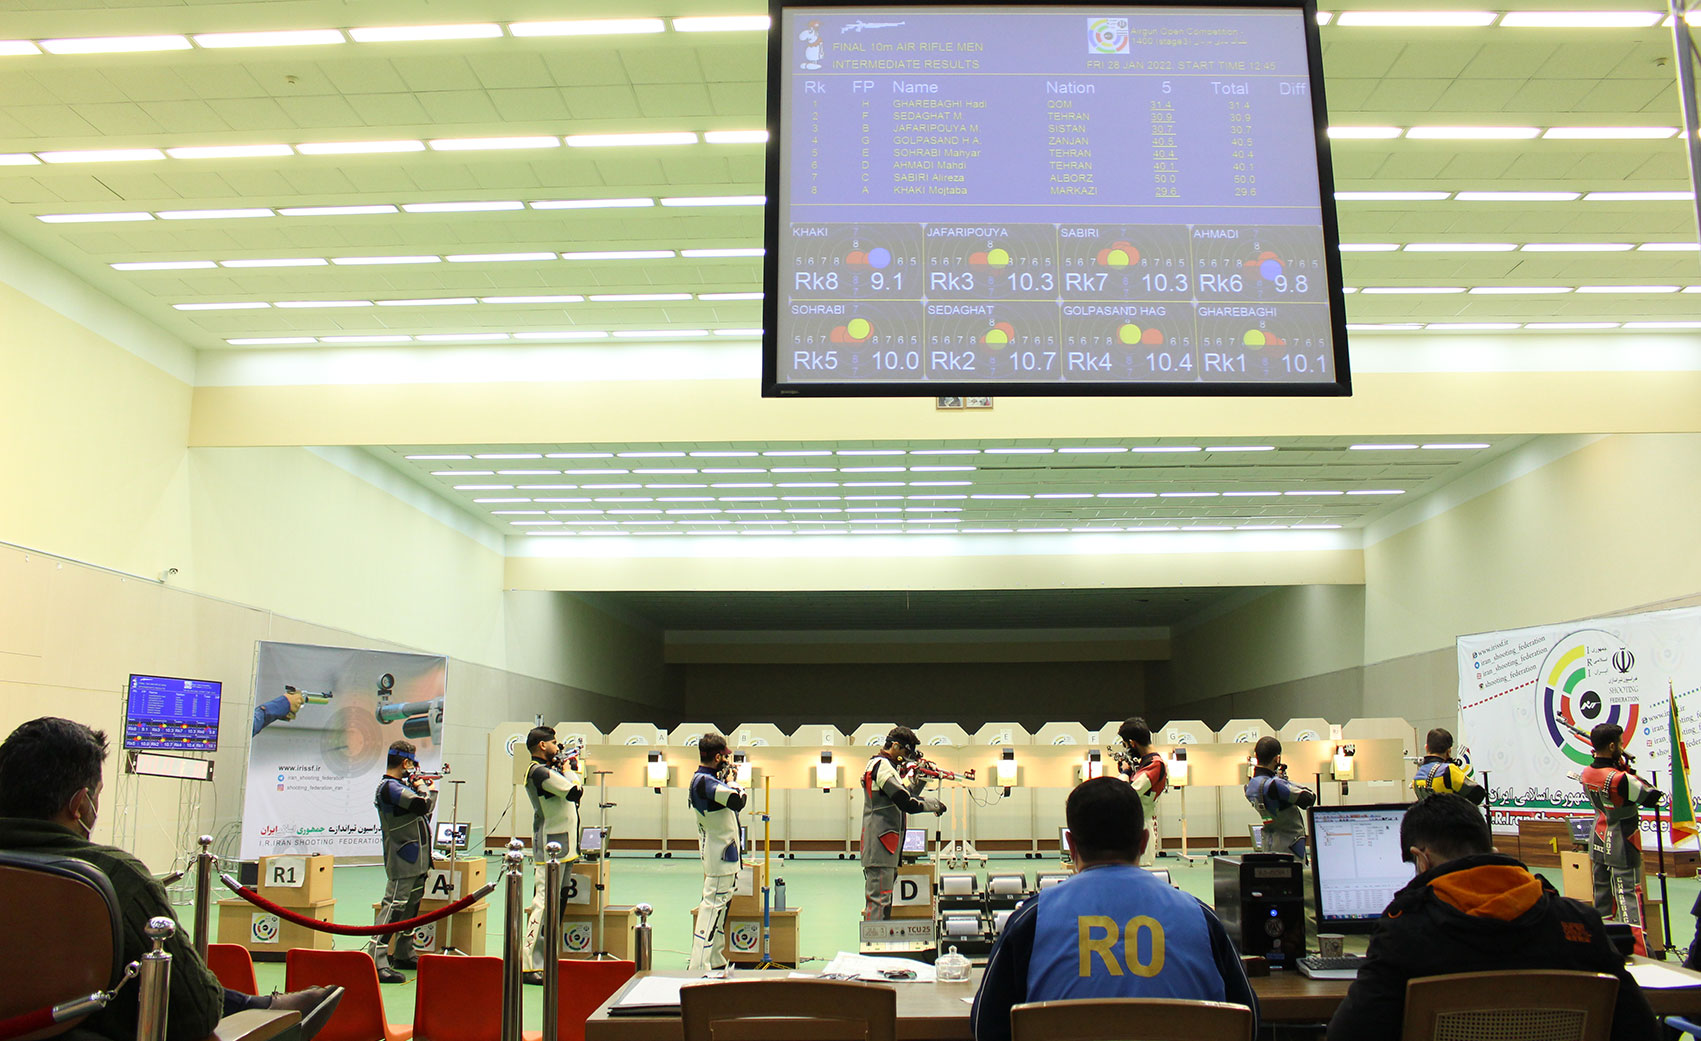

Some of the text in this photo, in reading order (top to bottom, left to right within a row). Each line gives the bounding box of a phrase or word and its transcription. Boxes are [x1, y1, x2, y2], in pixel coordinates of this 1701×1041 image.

[832, 43, 983, 52] FINAL 10m AIR RIFLE MEN
[832, 59, 980, 69] INTERMEDIATE RESULTS
[1087, 60, 1104, 70] FRI
[1108, 60, 1120, 70] 28
[1123, 60, 1144, 70] JAN
[1178, 61, 1215, 71] START
[1218, 61, 1246, 71] TIME
[1250, 61, 1276, 71] 12:45
[804, 80, 1306, 96] Rk FP Name Nation 5 Total Diff
[861, 99, 870, 108] H
[893, 99, 962, 109] GHAREBAGHI
[966, 100, 987, 109] Hadi
[1047, 100, 1073, 109] QOM
[1228, 101, 1251, 110] 31.4
[812, 111, 819, 121] 2
[862, 111, 869, 120] F
[893, 111, 951, 121] SEDAGHAT
[1047, 112, 1090, 121] TEHRAN
[1230, 113, 1252, 122] 30.9
[812, 123, 819, 133] 3
[862, 123, 870, 133] B
[892, 123, 967, 133] JAFARIPOUYA
[1047, 124, 1086, 133] SISTAN
[1231, 125, 1252, 134] 30.7
[811, 135, 818, 144] 4
[861, 135, 870, 145] G
[893, 135, 960, 145] GOLPASAND
[962, 136, 970, 145] H
[1047, 136, 1089, 146] ZANJAN
[1231, 137, 1254, 147] 40.5
[811, 148, 818, 158] 5
[861, 148, 870, 158] E
[893, 148, 940, 158] SOHRABI
[1048, 149, 1092, 158] TEHRAN
[1231, 150, 1254, 159] 40.4
[811, 160, 818, 170] 6
[861, 160, 870, 170] D
[893, 160, 935, 170] AHMADI
[1049, 161, 1093, 170] TEHRAN
[811, 172, 1256, 184] 7 C SABIRI Alireza ALBORZ 50.0 50.0
[811, 185, 818, 195] 8
[861, 185, 870, 195] A
[893, 185, 926, 195] KHAKI
[928, 185, 968, 196] Mojtaba
[1050, 186, 1098, 196] MARKAZI
[1234, 187, 1257, 197] 29.6
[792, 227, 828, 237] KHAKI
[927, 227, 1008, 237] JAFARIPOUYA
[1060, 228, 1099, 238] SABIRI
[1193, 229, 1239, 239] AHMADI
[795, 271, 902, 290] Rk8 9.1
[930, 272, 1054, 291] Rk3 10.3
[1065, 272, 1188, 292] Rk7 10.3
[1199, 273, 1309, 293] Rk6 9.8
[791, 304, 845, 315] SOHRABI
[927, 305, 995, 315] SEDAGHAT
[1063, 305, 1167, 316] GOLPASAND HAG
[1198, 306, 1277, 317] GHAREBAGHI
[793, 351, 919, 370] Rk5 10.0
[931, 351, 1057, 371] Rk2 10.7
[1068, 351, 1193, 372] Rk4 10.4
[1204, 352, 1326, 373] Rk1 10.1
[1608, 686, 1639, 695] SHOOTING
[1609, 696, 1640, 704] FEDERATION
[278, 764, 321, 772] www.irissf.ir
[1489, 786, 1590, 808] مهوری اسلامی ایران
[260, 825, 279, 836] ایران
[294, 838, 334, 847] SHOOTING
[1548, 836, 1558, 854] 1
[273, 866, 297, 884] R1
[431, 874, 450, 895] A
[900, 879, 918, 901] D
[1077, 914, 1166, 978] RO
